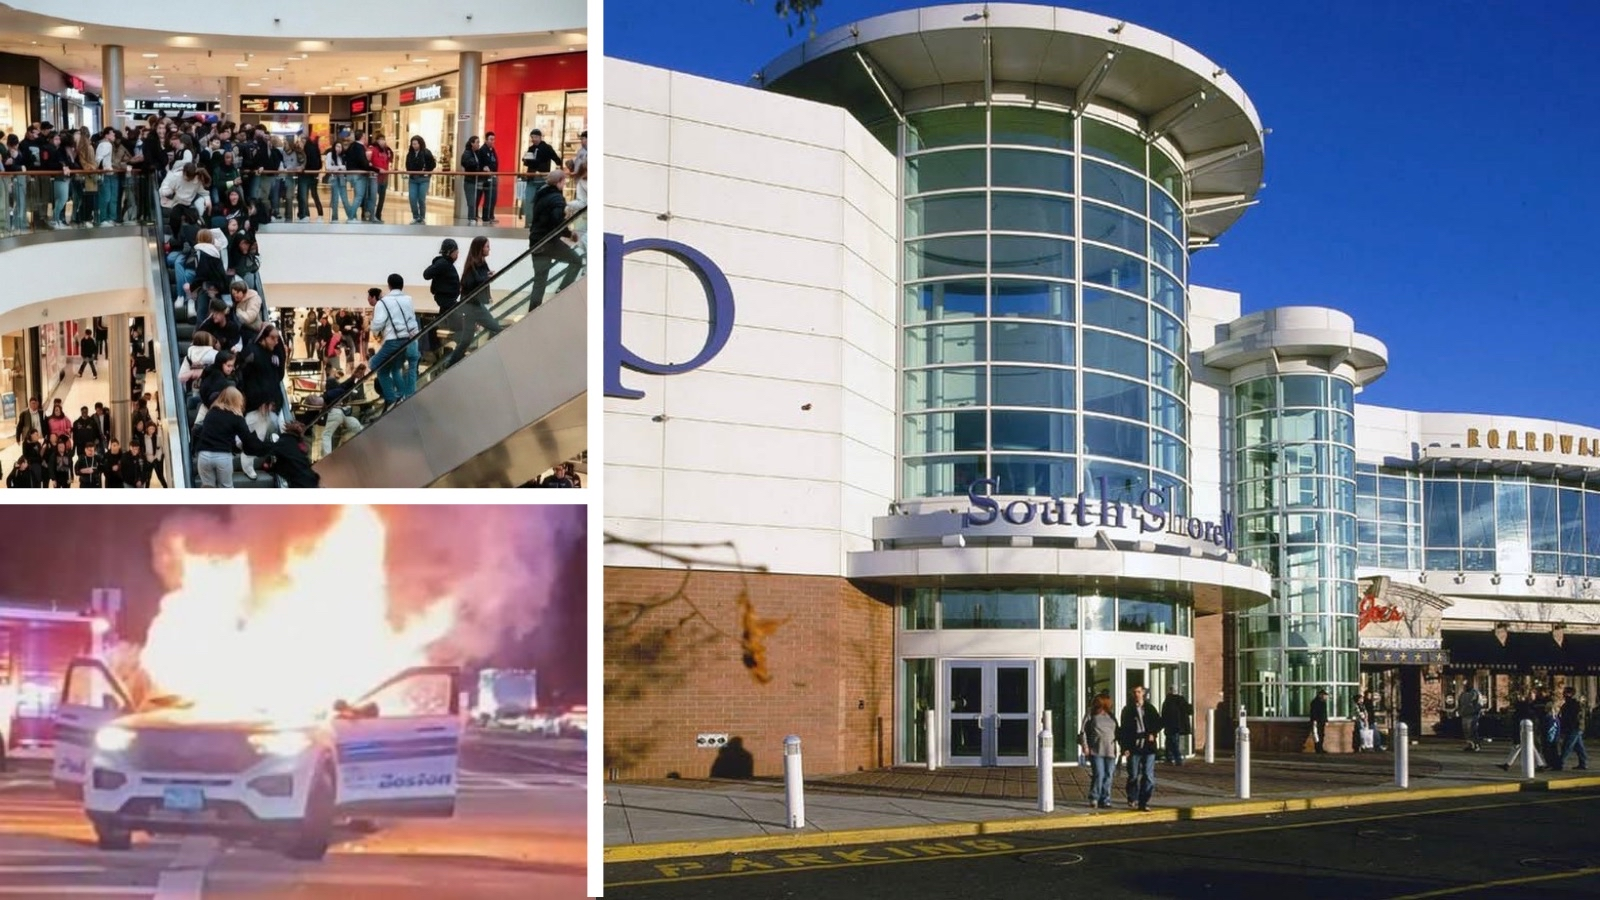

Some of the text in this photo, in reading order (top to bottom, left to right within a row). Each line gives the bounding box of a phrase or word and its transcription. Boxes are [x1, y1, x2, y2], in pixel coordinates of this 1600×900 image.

[962, 475, 1127, 528] South
[1139, 484, 1223, 546] Shore
[1135, 641, 1164, 651] Entrance
[378, 772, 452, 788] Boston
[654, 838, 1014, 879] PARKING
